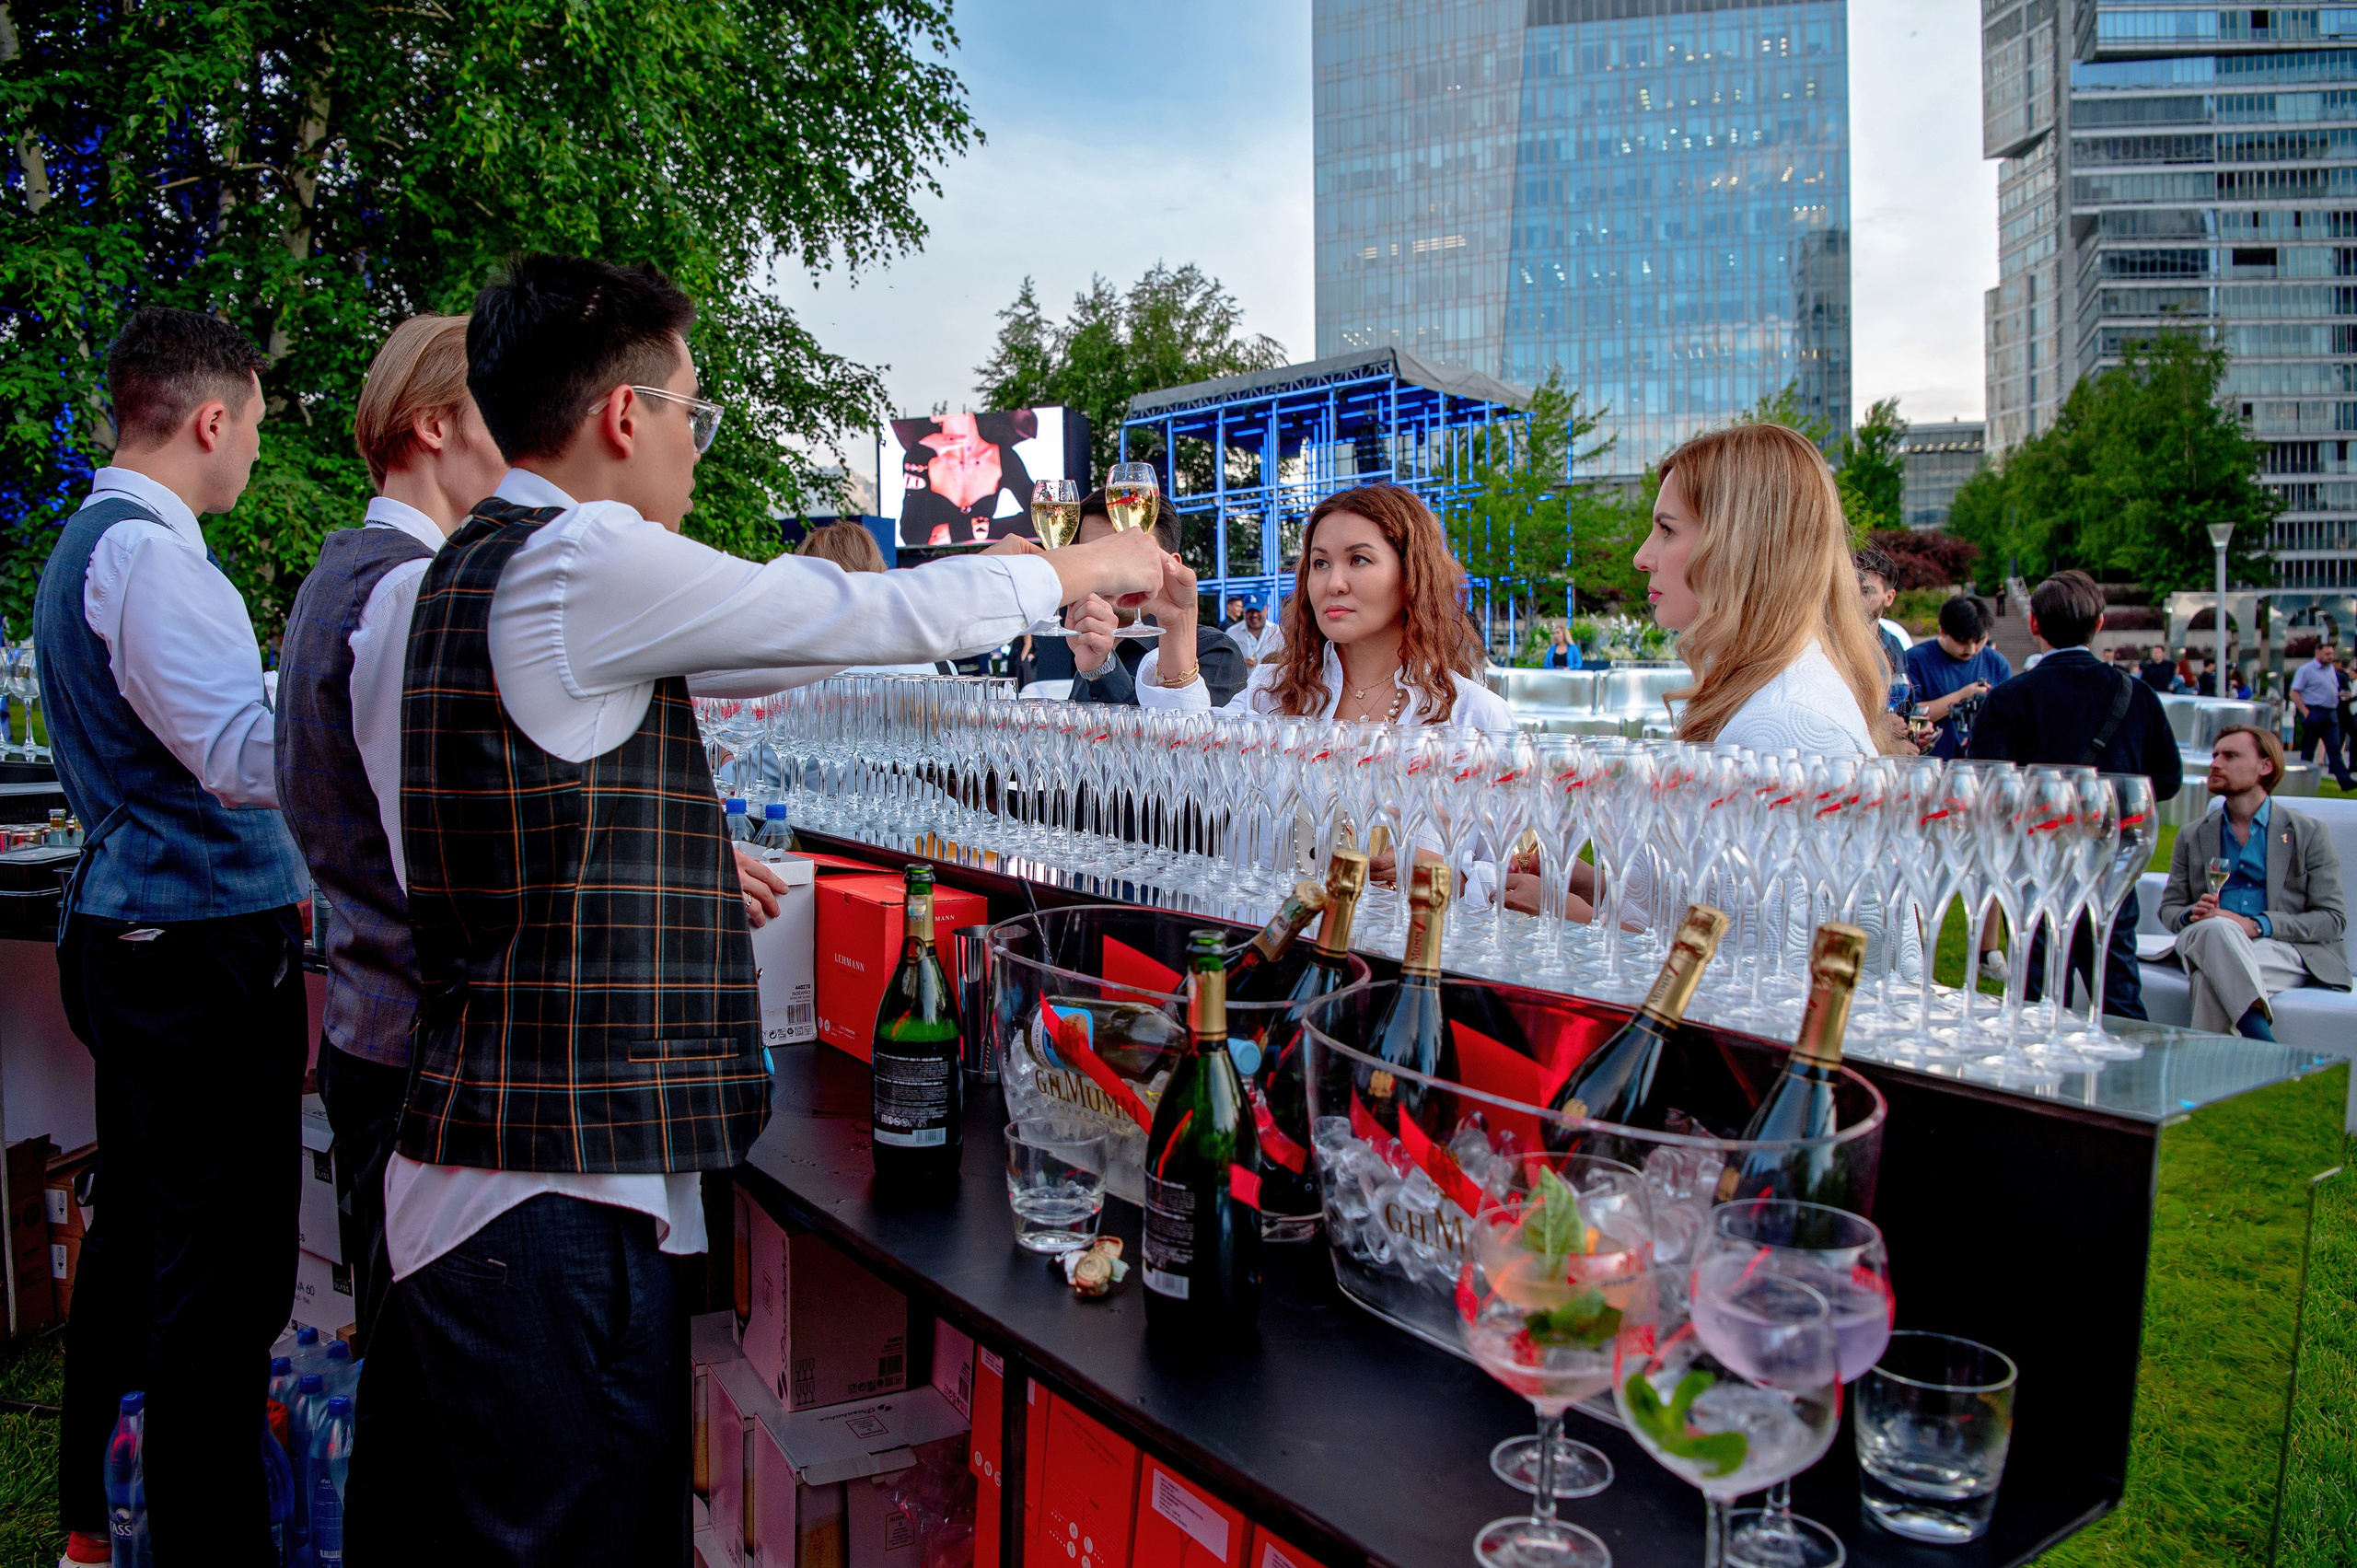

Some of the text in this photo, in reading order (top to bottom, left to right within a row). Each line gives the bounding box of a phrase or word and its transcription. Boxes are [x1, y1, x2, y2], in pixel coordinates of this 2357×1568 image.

[834, 952, 865, 972] LEHMANN
[1385, 1202, 1466, 1256] G.H.M
[306, 1284, 315, 1296] 60
